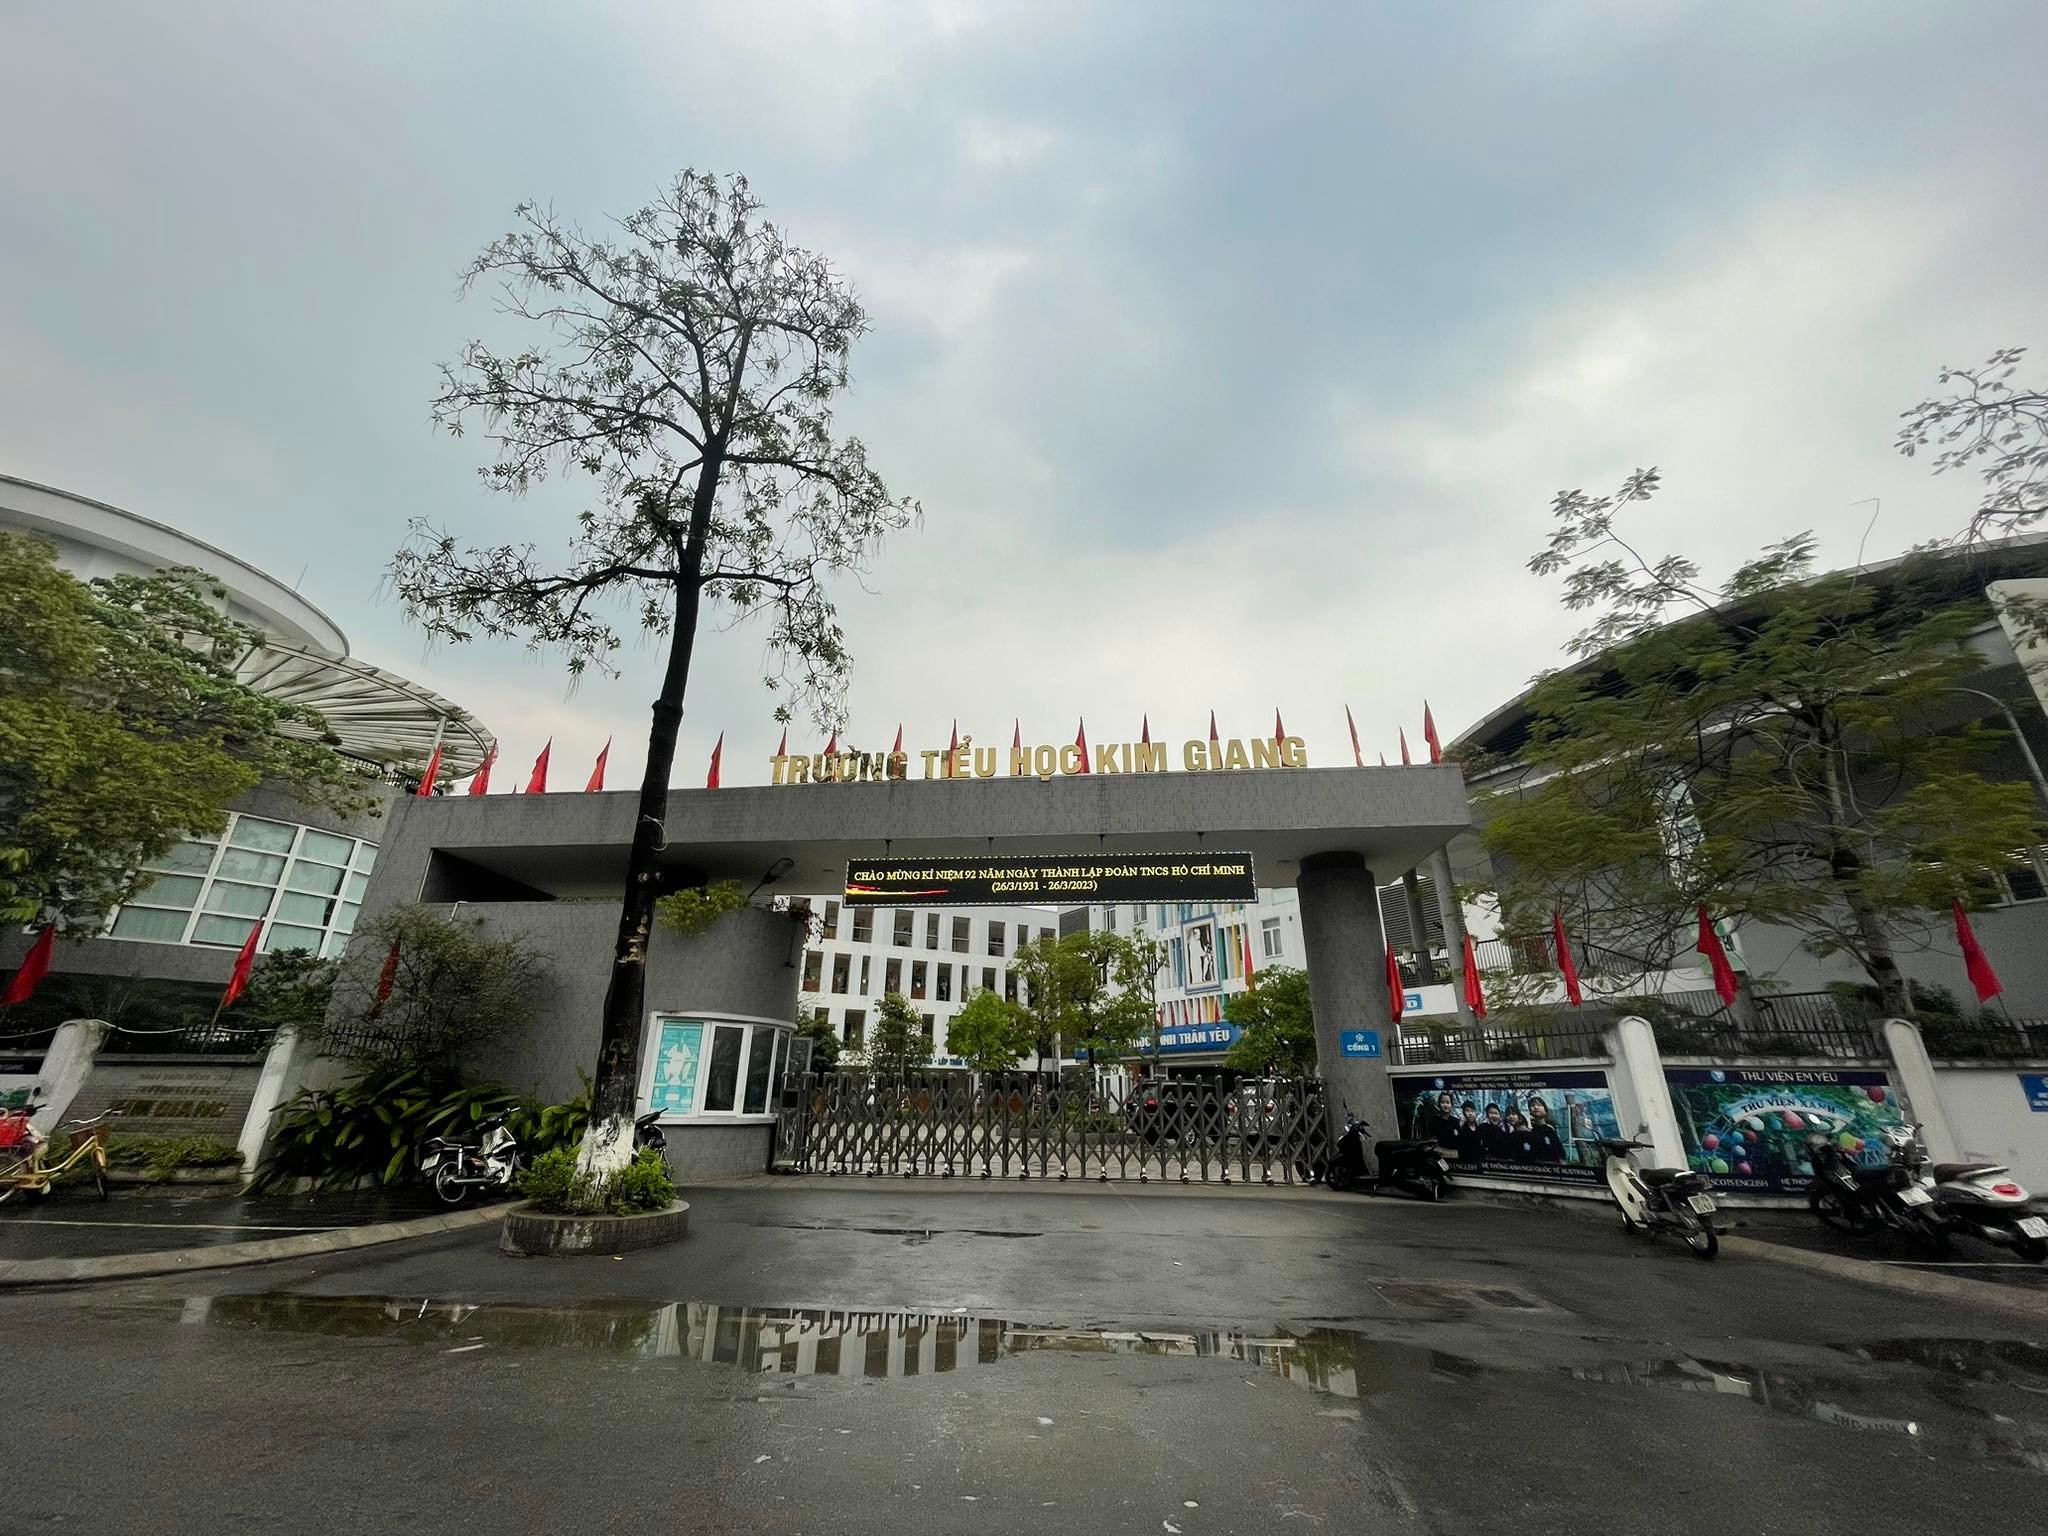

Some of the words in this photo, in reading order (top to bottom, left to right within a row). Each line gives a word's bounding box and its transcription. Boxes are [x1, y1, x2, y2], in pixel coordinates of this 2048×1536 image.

[920, 734, 997, 780] TIỂU
[1010, 744, 1082, 782] HỌC
[1096, 741, 1168, 774] KIM
[1183, 736, 1307, 771] GIANG
[854, 869, 885, 881] CHÀO
[886, 867, 921, 880] MỪNG
[936, 868, 964, 881] NIỆM
[965, 869, 977, 879] 92
[979, 867, 1005, 879] NĂM
[1006, 867, 1038, 878] NGÀY
[1041, 866, 1080, 878] THÀNH
[1105, 865, 1138, 877] ĐOÀN
[1140, 866, 1169, 876] TNCS
[1190, 863, 1211, 875] CHÍ
[1213, 865, 1245, 875] MINH
[991, 881, 1040, 893] (26/3/1931
[1048, 880, 1098, 891] 26/3/2023)
[1178, 1029, 1207, 1045] THÂN
[1209, 1026, 1230, 1043] YÊU
[1796, 1071, 1813, 1082] EM
